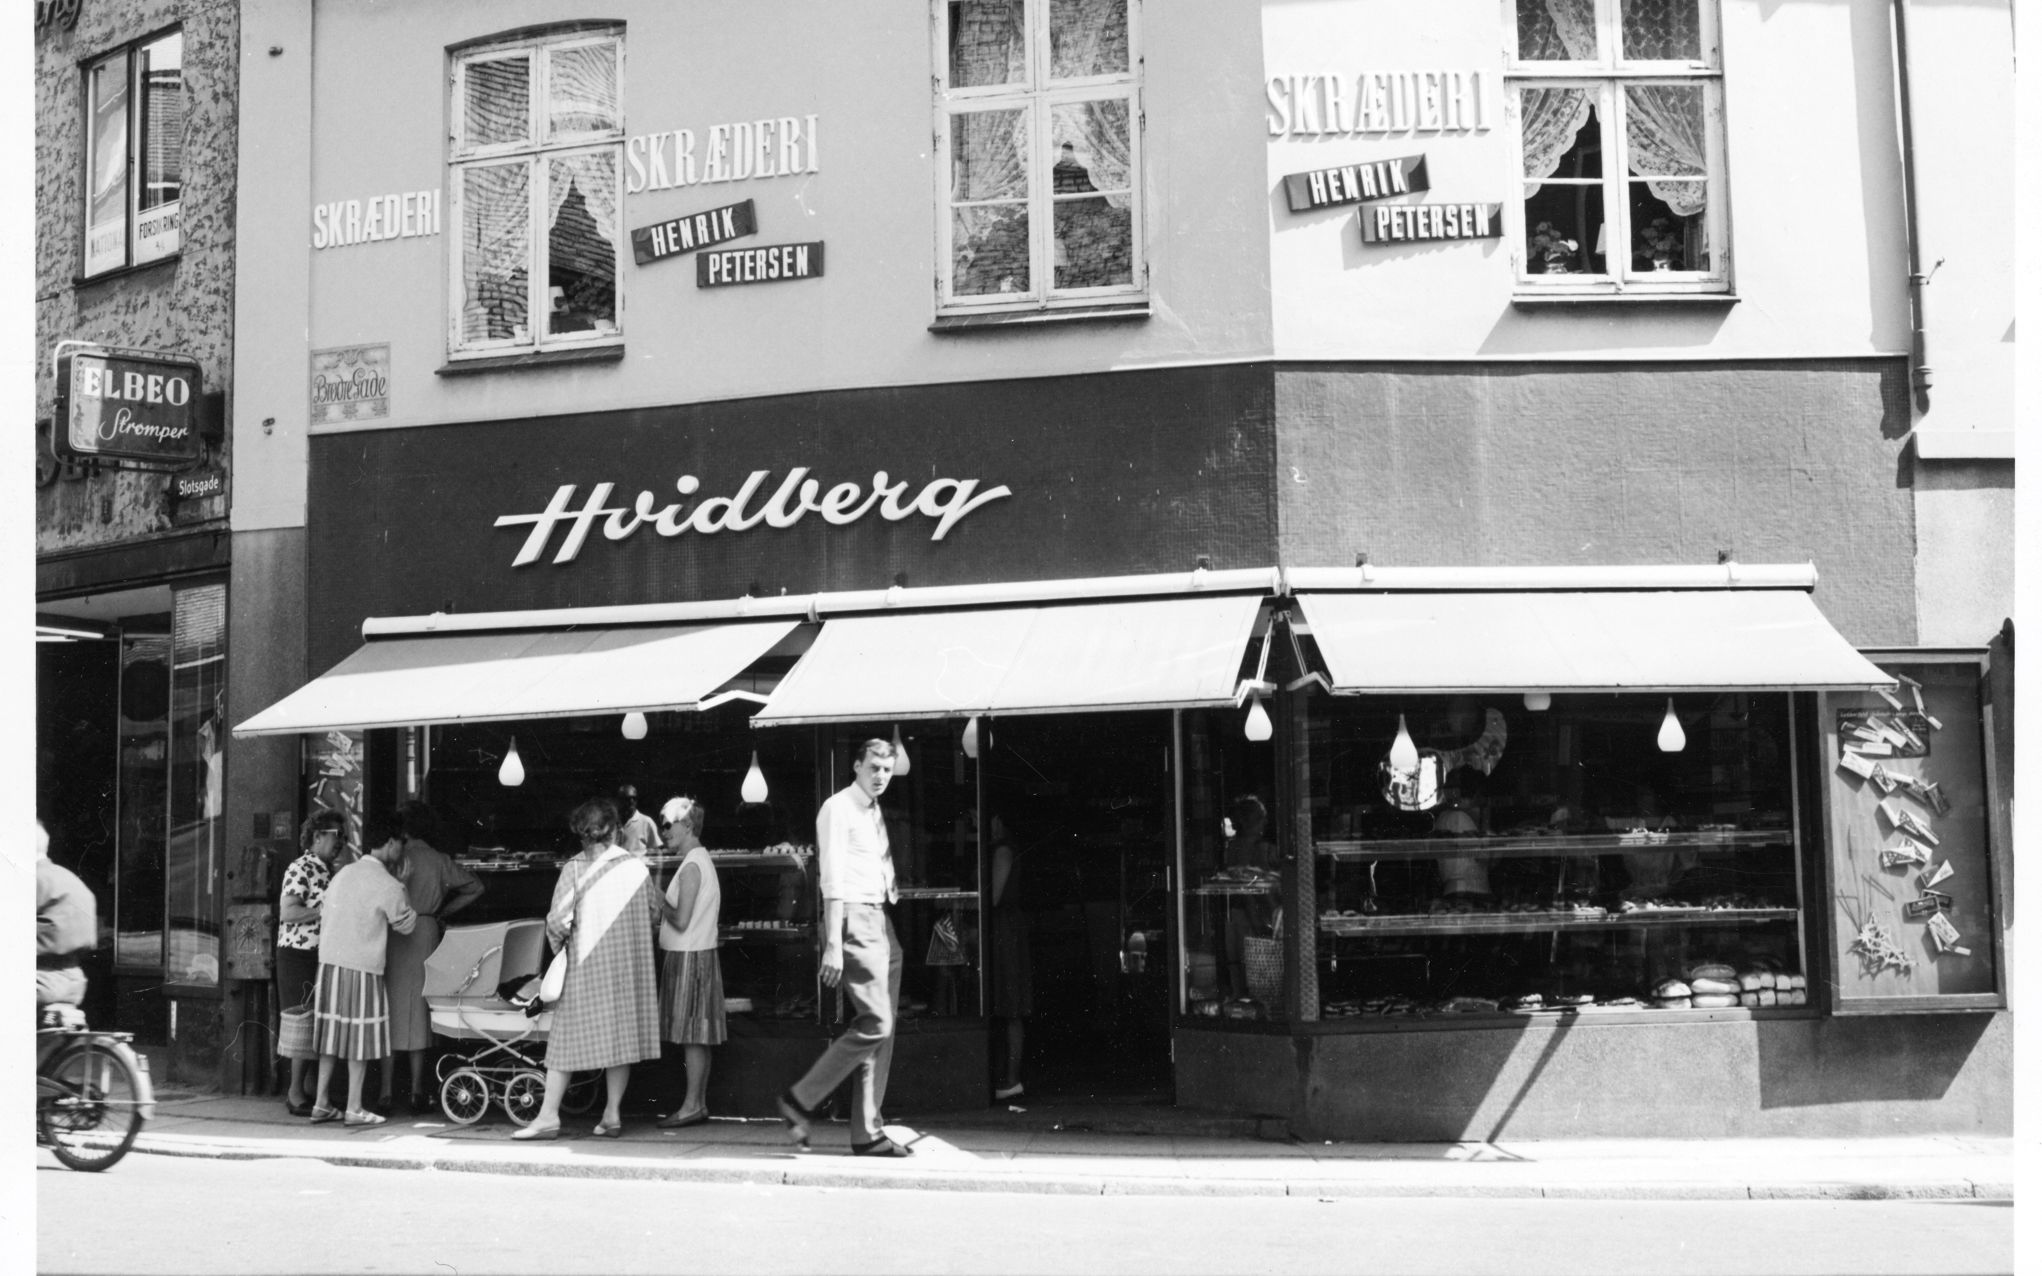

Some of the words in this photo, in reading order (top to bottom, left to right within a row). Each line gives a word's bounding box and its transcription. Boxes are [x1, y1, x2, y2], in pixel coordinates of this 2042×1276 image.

[1266, 70, 1491, 136] SKRÆDERI
[626, 114, 819, 194] SKRÆDERI
[1309, 159, 1406, 204] HENRIK
[138, 212, 179, 241] FORSIKRING
[313, 188, 441, 250] SKRÆDERI
[650, 207, 736, 257] HENRIK
[1376, 204, 1490, 240] PETERSEN
[708, 245, 808, 284] PETERSEN
[84, 367, 190, 406] ELBEO
[178, 473, 220, 497] Slotsgade
[493, 466, 1013, 568] Hvidberg
